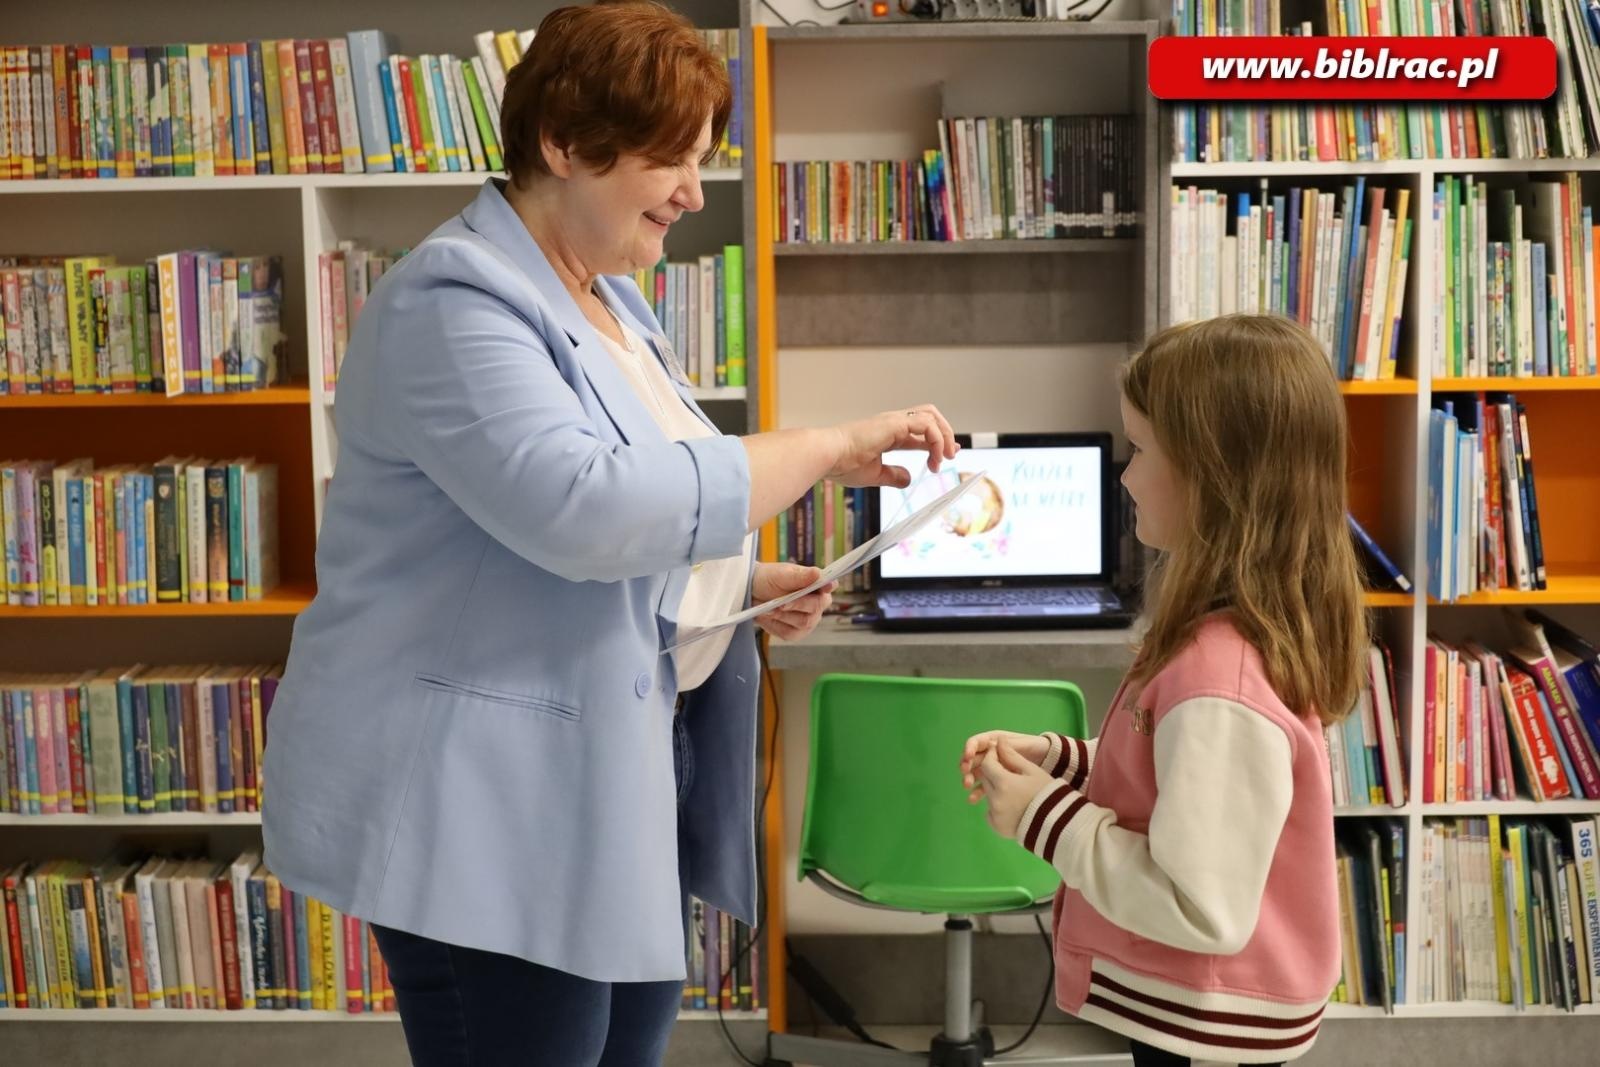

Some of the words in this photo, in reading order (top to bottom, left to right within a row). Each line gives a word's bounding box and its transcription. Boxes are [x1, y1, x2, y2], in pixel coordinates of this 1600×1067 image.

[164, 271, 175, 314] LAT
[1578, 828, 1593, 858] 365
[1582, 860, 1597, 898] SUPER
